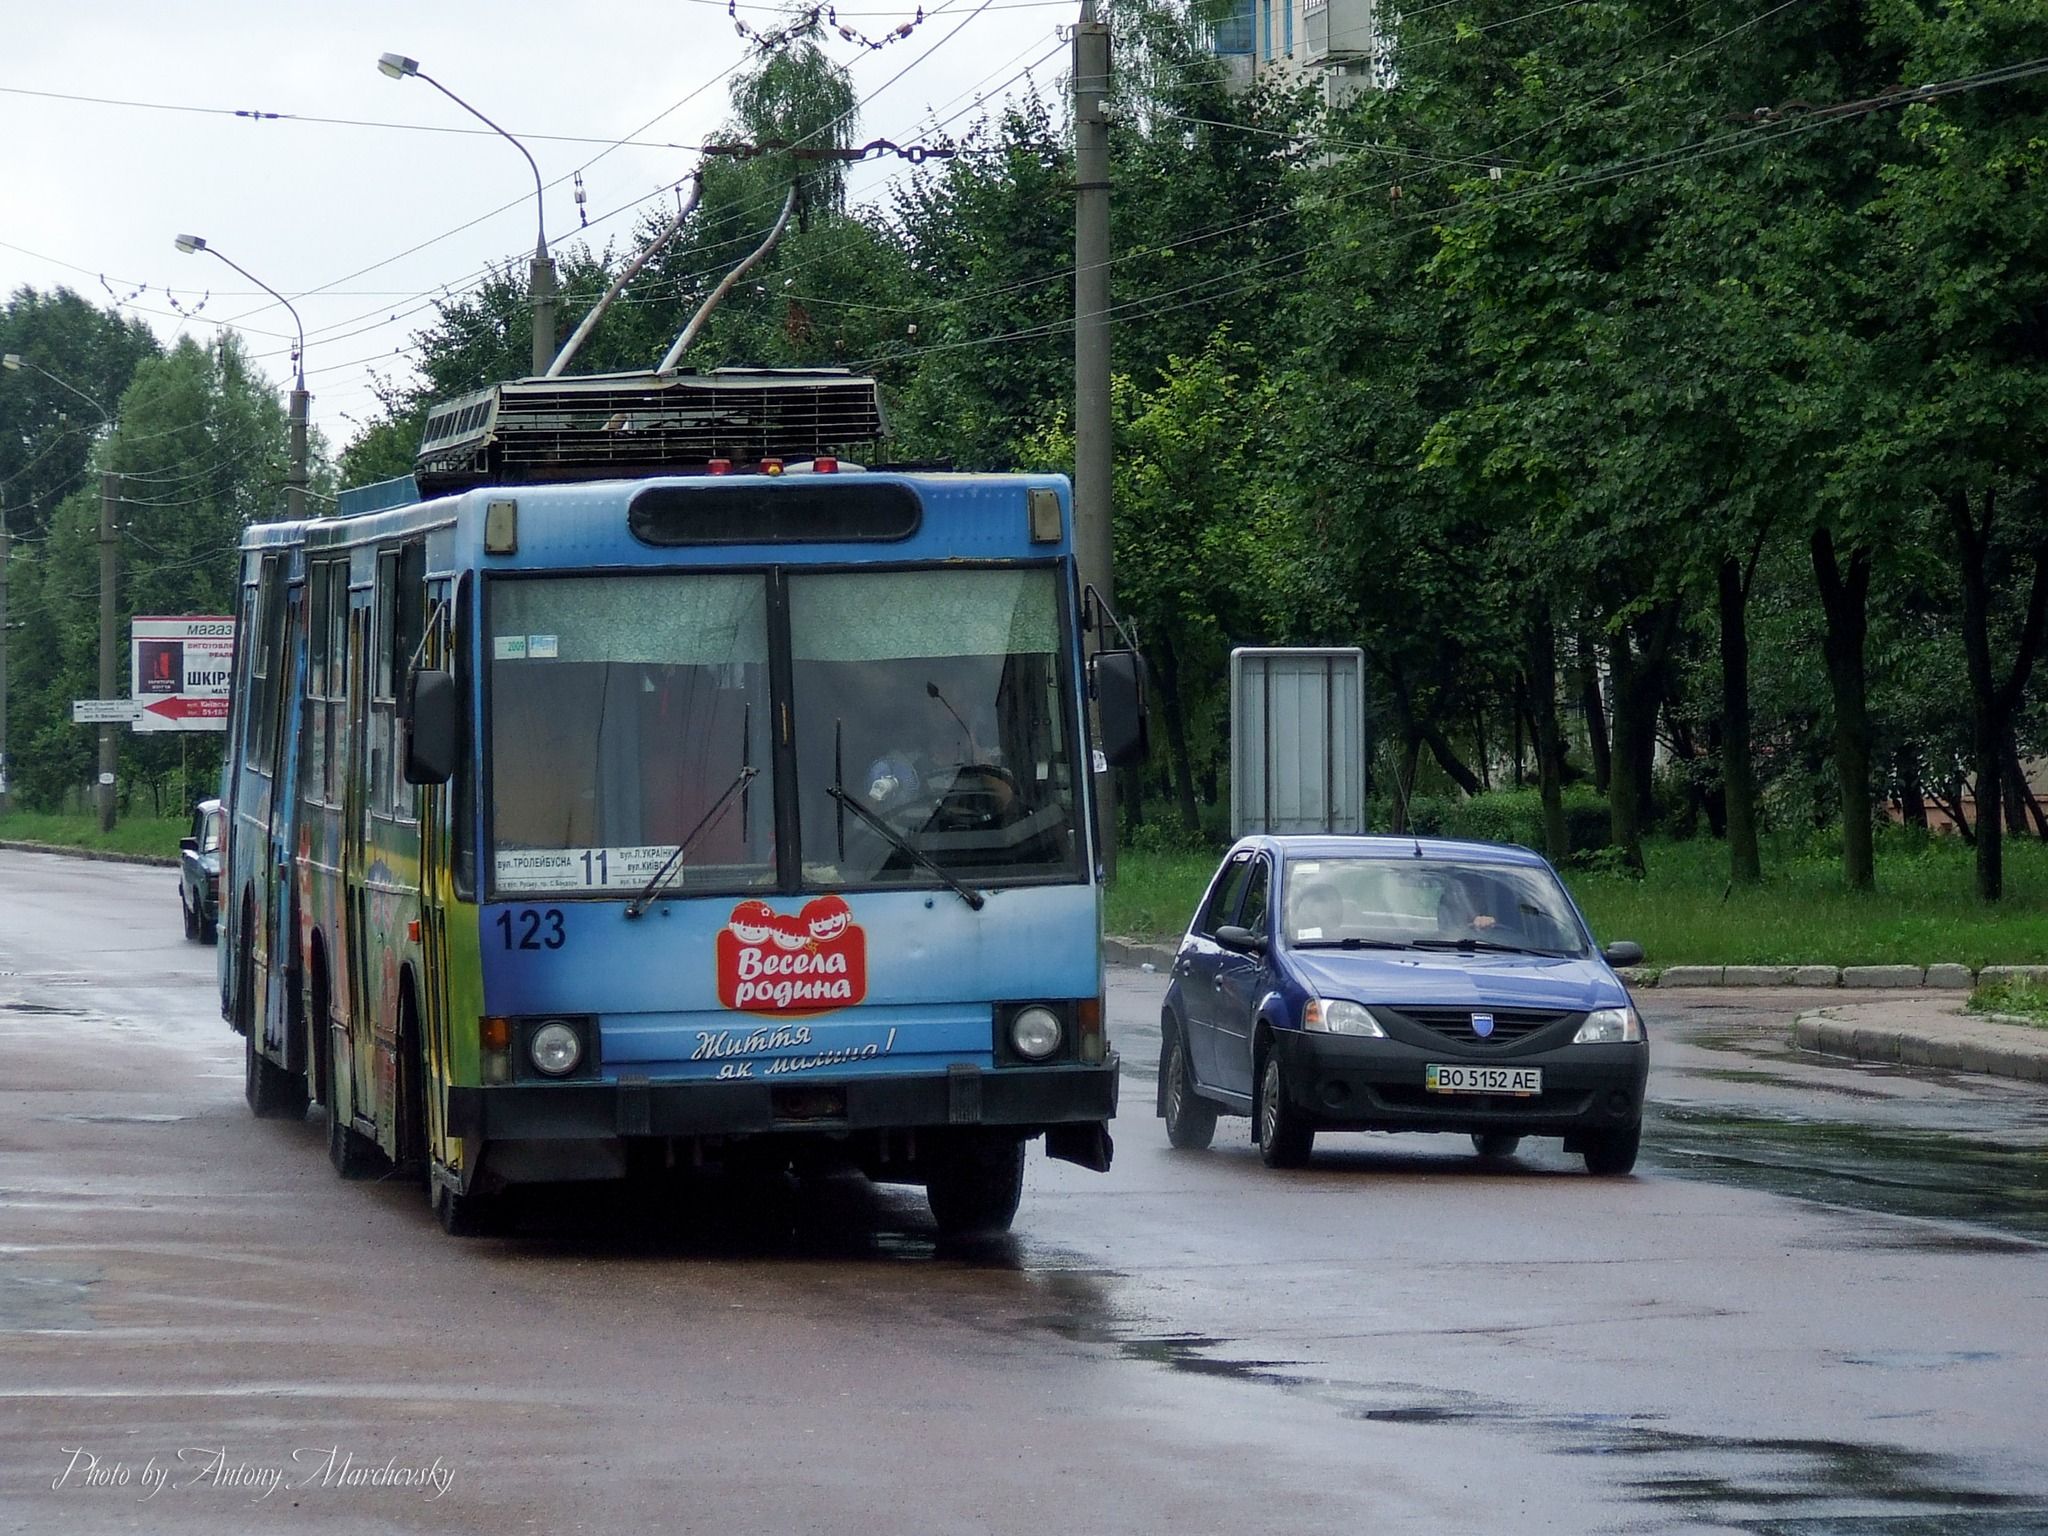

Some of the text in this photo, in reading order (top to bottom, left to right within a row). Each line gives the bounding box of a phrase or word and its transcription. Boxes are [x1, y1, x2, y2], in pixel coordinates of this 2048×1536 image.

[580, 849, 608, 885] 11
[496, 908, 566, 950] 123
[737, 947, 847, 980] Весела
[735, 978, 852, 1008] родина
[690, 1024, 812, 1061] Життя
[715, 1062, 753, 1081] як
[1438, 1069, 1537, 1089] BO 5152 AE
